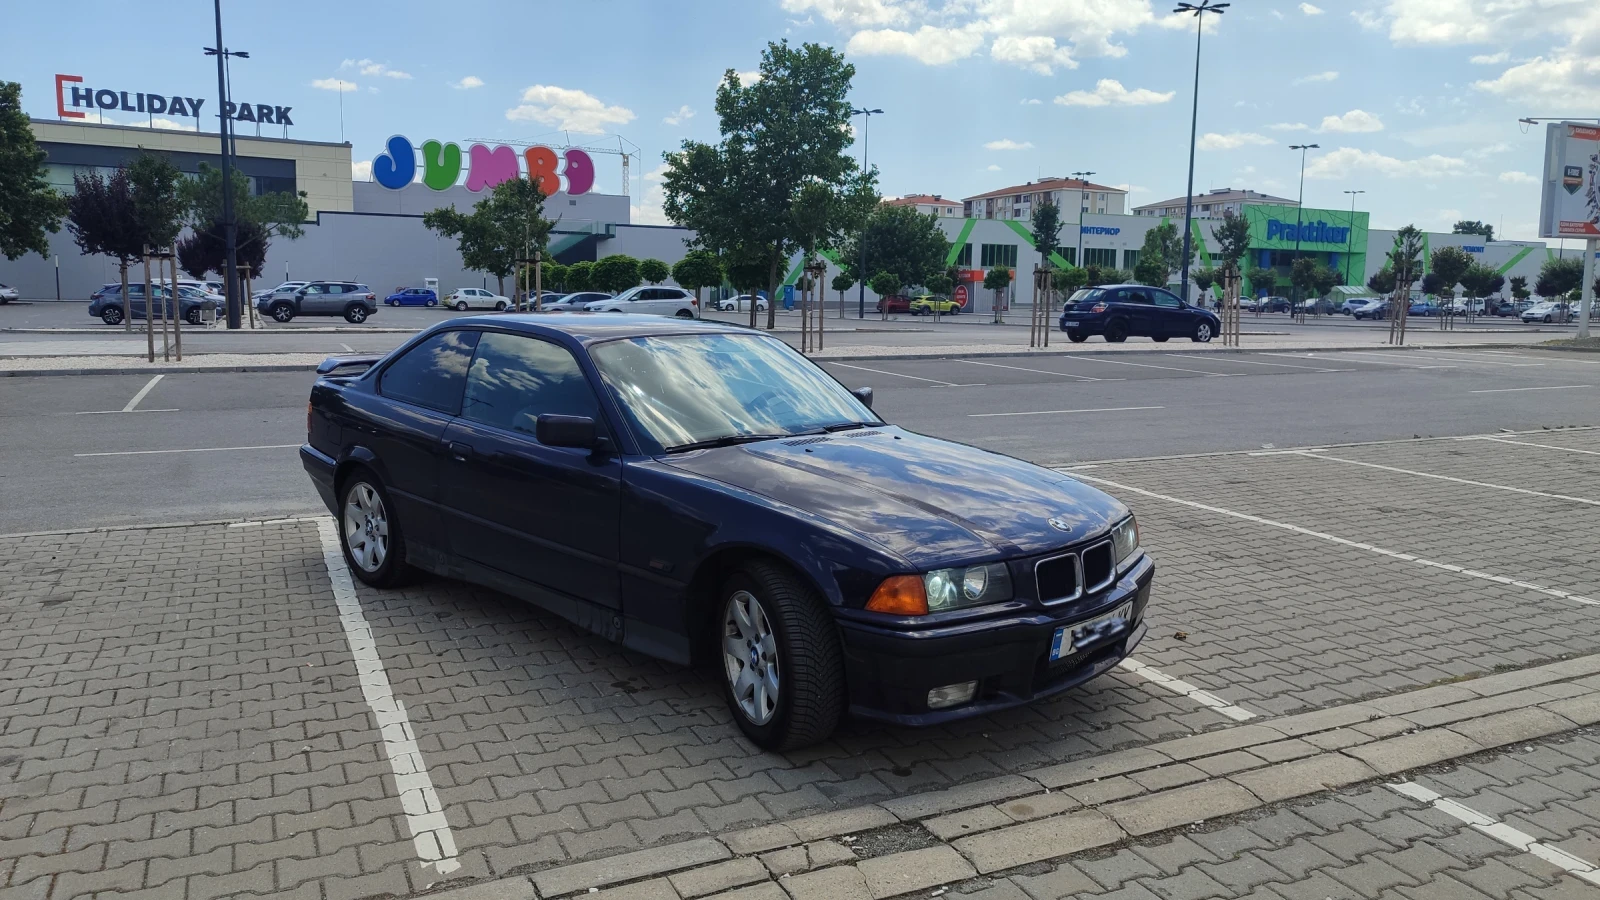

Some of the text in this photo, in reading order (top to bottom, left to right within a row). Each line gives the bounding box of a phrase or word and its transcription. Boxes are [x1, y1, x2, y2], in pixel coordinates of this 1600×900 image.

[71, 87, 294, 125] HOLIDAY PARK
[372, 134, 595, 196] JUMBO
[1081, 226, 1120, 235] ИНТЕРИОР
[1267, 219, 1350, 243] Praktiker
